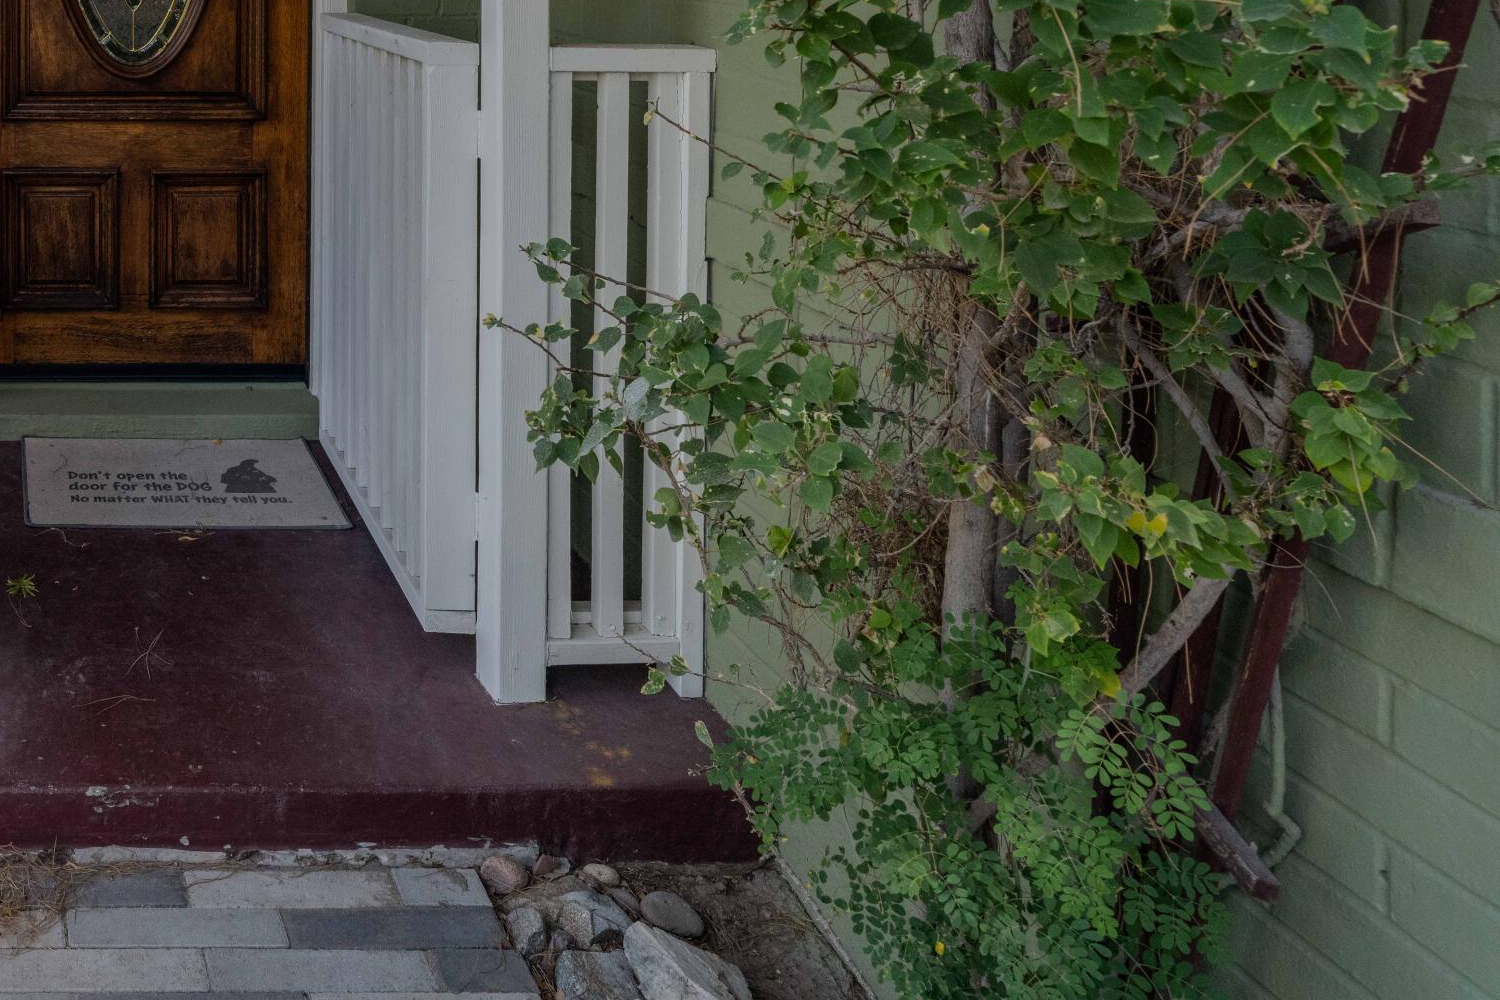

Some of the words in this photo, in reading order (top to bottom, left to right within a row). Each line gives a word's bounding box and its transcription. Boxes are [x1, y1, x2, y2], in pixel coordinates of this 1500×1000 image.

[67, 470, 112, 480] Don't
[116, 471, 156, 482] open
[160, 470, 188, 481] the
[68, 481, 108, 491] door
[112, 481, 138, 491] for
[143, 481, 173, 492] the
[176, 481, 213, 492] DOG
[70, 494, 91, 503] No
[93, 494, 148, 503] matter
[150, 494, 190, 504] WHAT
[195, 494, 228, 505] they
[232, 494, 258, 504] tell
